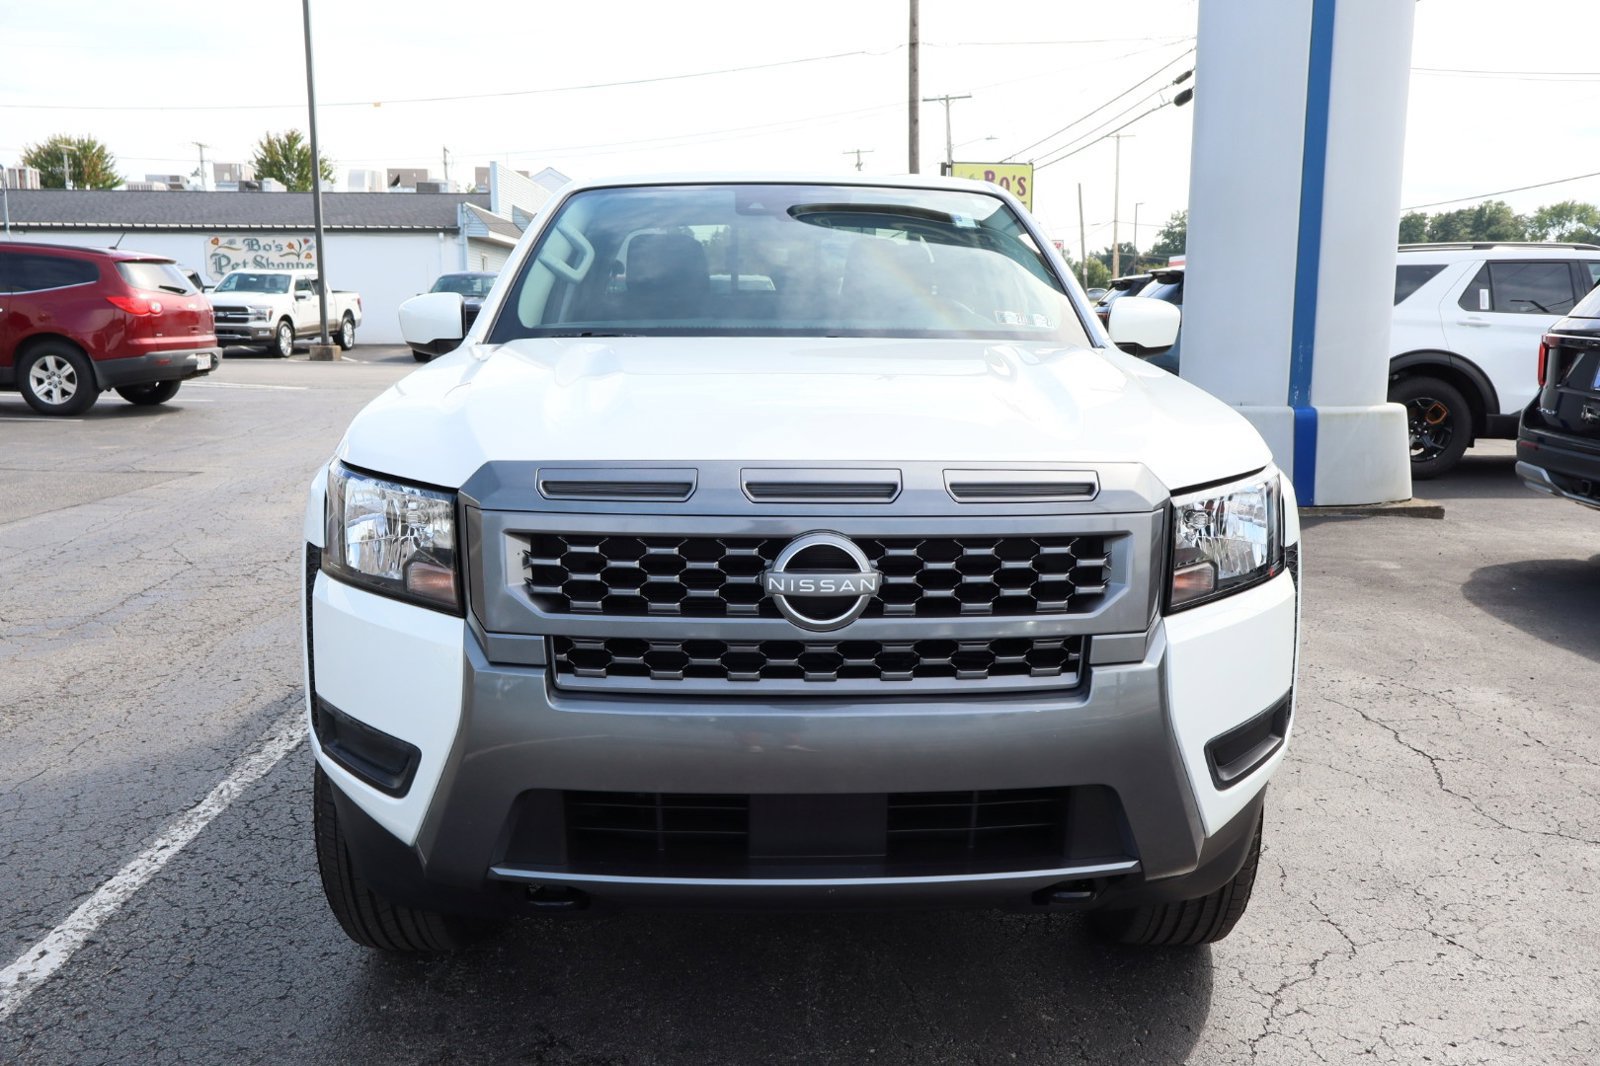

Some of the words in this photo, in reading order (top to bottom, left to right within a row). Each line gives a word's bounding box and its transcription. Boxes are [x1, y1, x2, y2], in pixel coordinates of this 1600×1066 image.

[243, 238, 283, 252] Bo's
[210, 253, 248, 275] Pet
[768, 578, 876, 592] NISSAN
